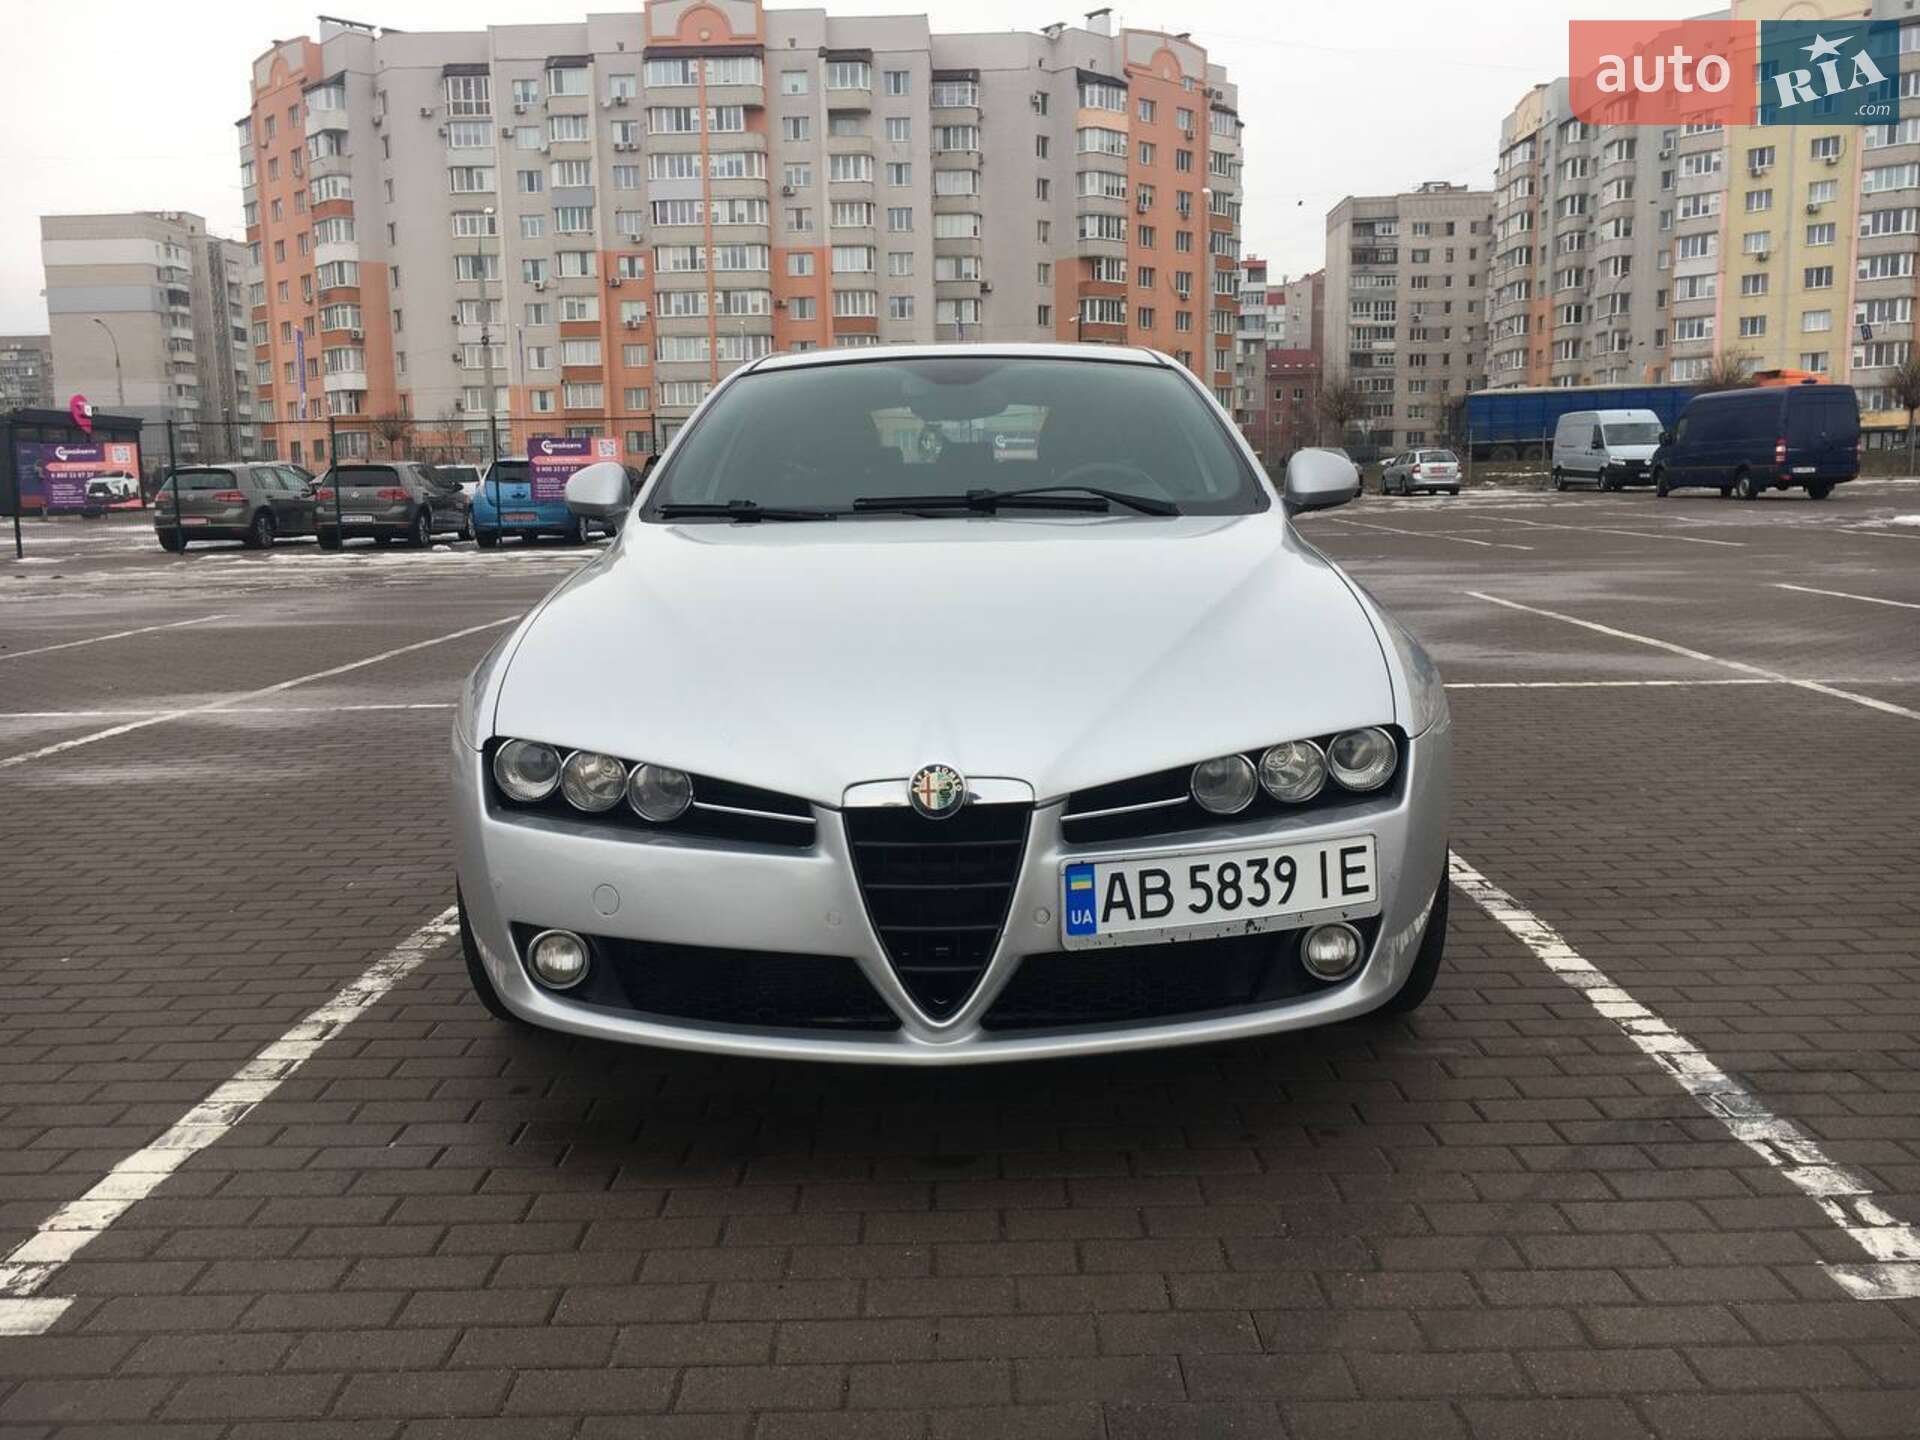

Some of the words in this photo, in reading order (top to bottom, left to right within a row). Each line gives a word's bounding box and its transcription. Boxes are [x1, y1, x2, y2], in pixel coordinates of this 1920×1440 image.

[1101, 868, 1174, 922] AB
[1188, 855, 1298, 914] 5839
[1320, 845, 1370, 899] IE
[1071, 909, 1093, 925] UA
